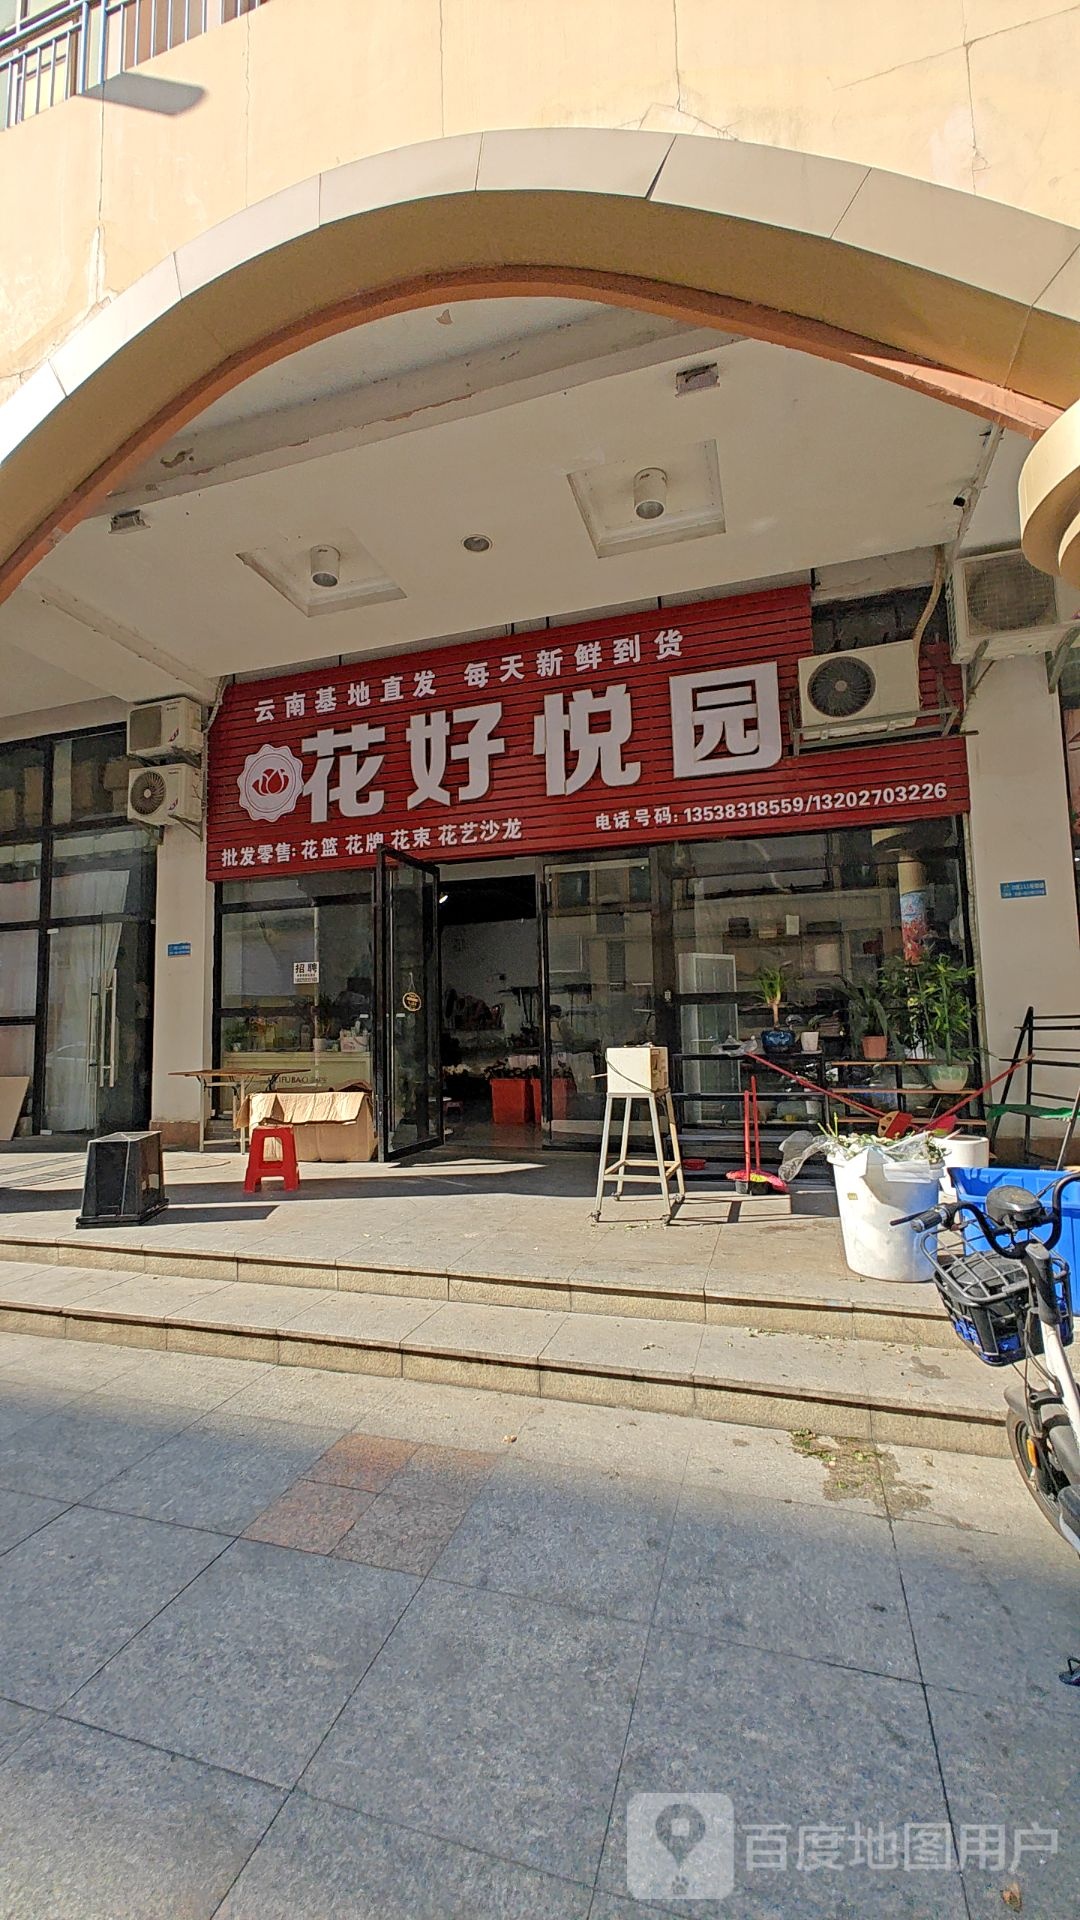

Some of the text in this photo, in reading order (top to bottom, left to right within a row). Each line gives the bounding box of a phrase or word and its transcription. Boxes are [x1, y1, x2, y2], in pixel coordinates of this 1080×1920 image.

[254, 629, 684, 723] 云南基地直发 每天新鲜到货
[301, 661, 783, 823] 花好悦园
[301, 837, 339, 861] 花篮
[345, 832, 384, 856] 花牌
[391, 826, 432, 850] 花束
[438, 817, 523, 847] 花艺沙龙
